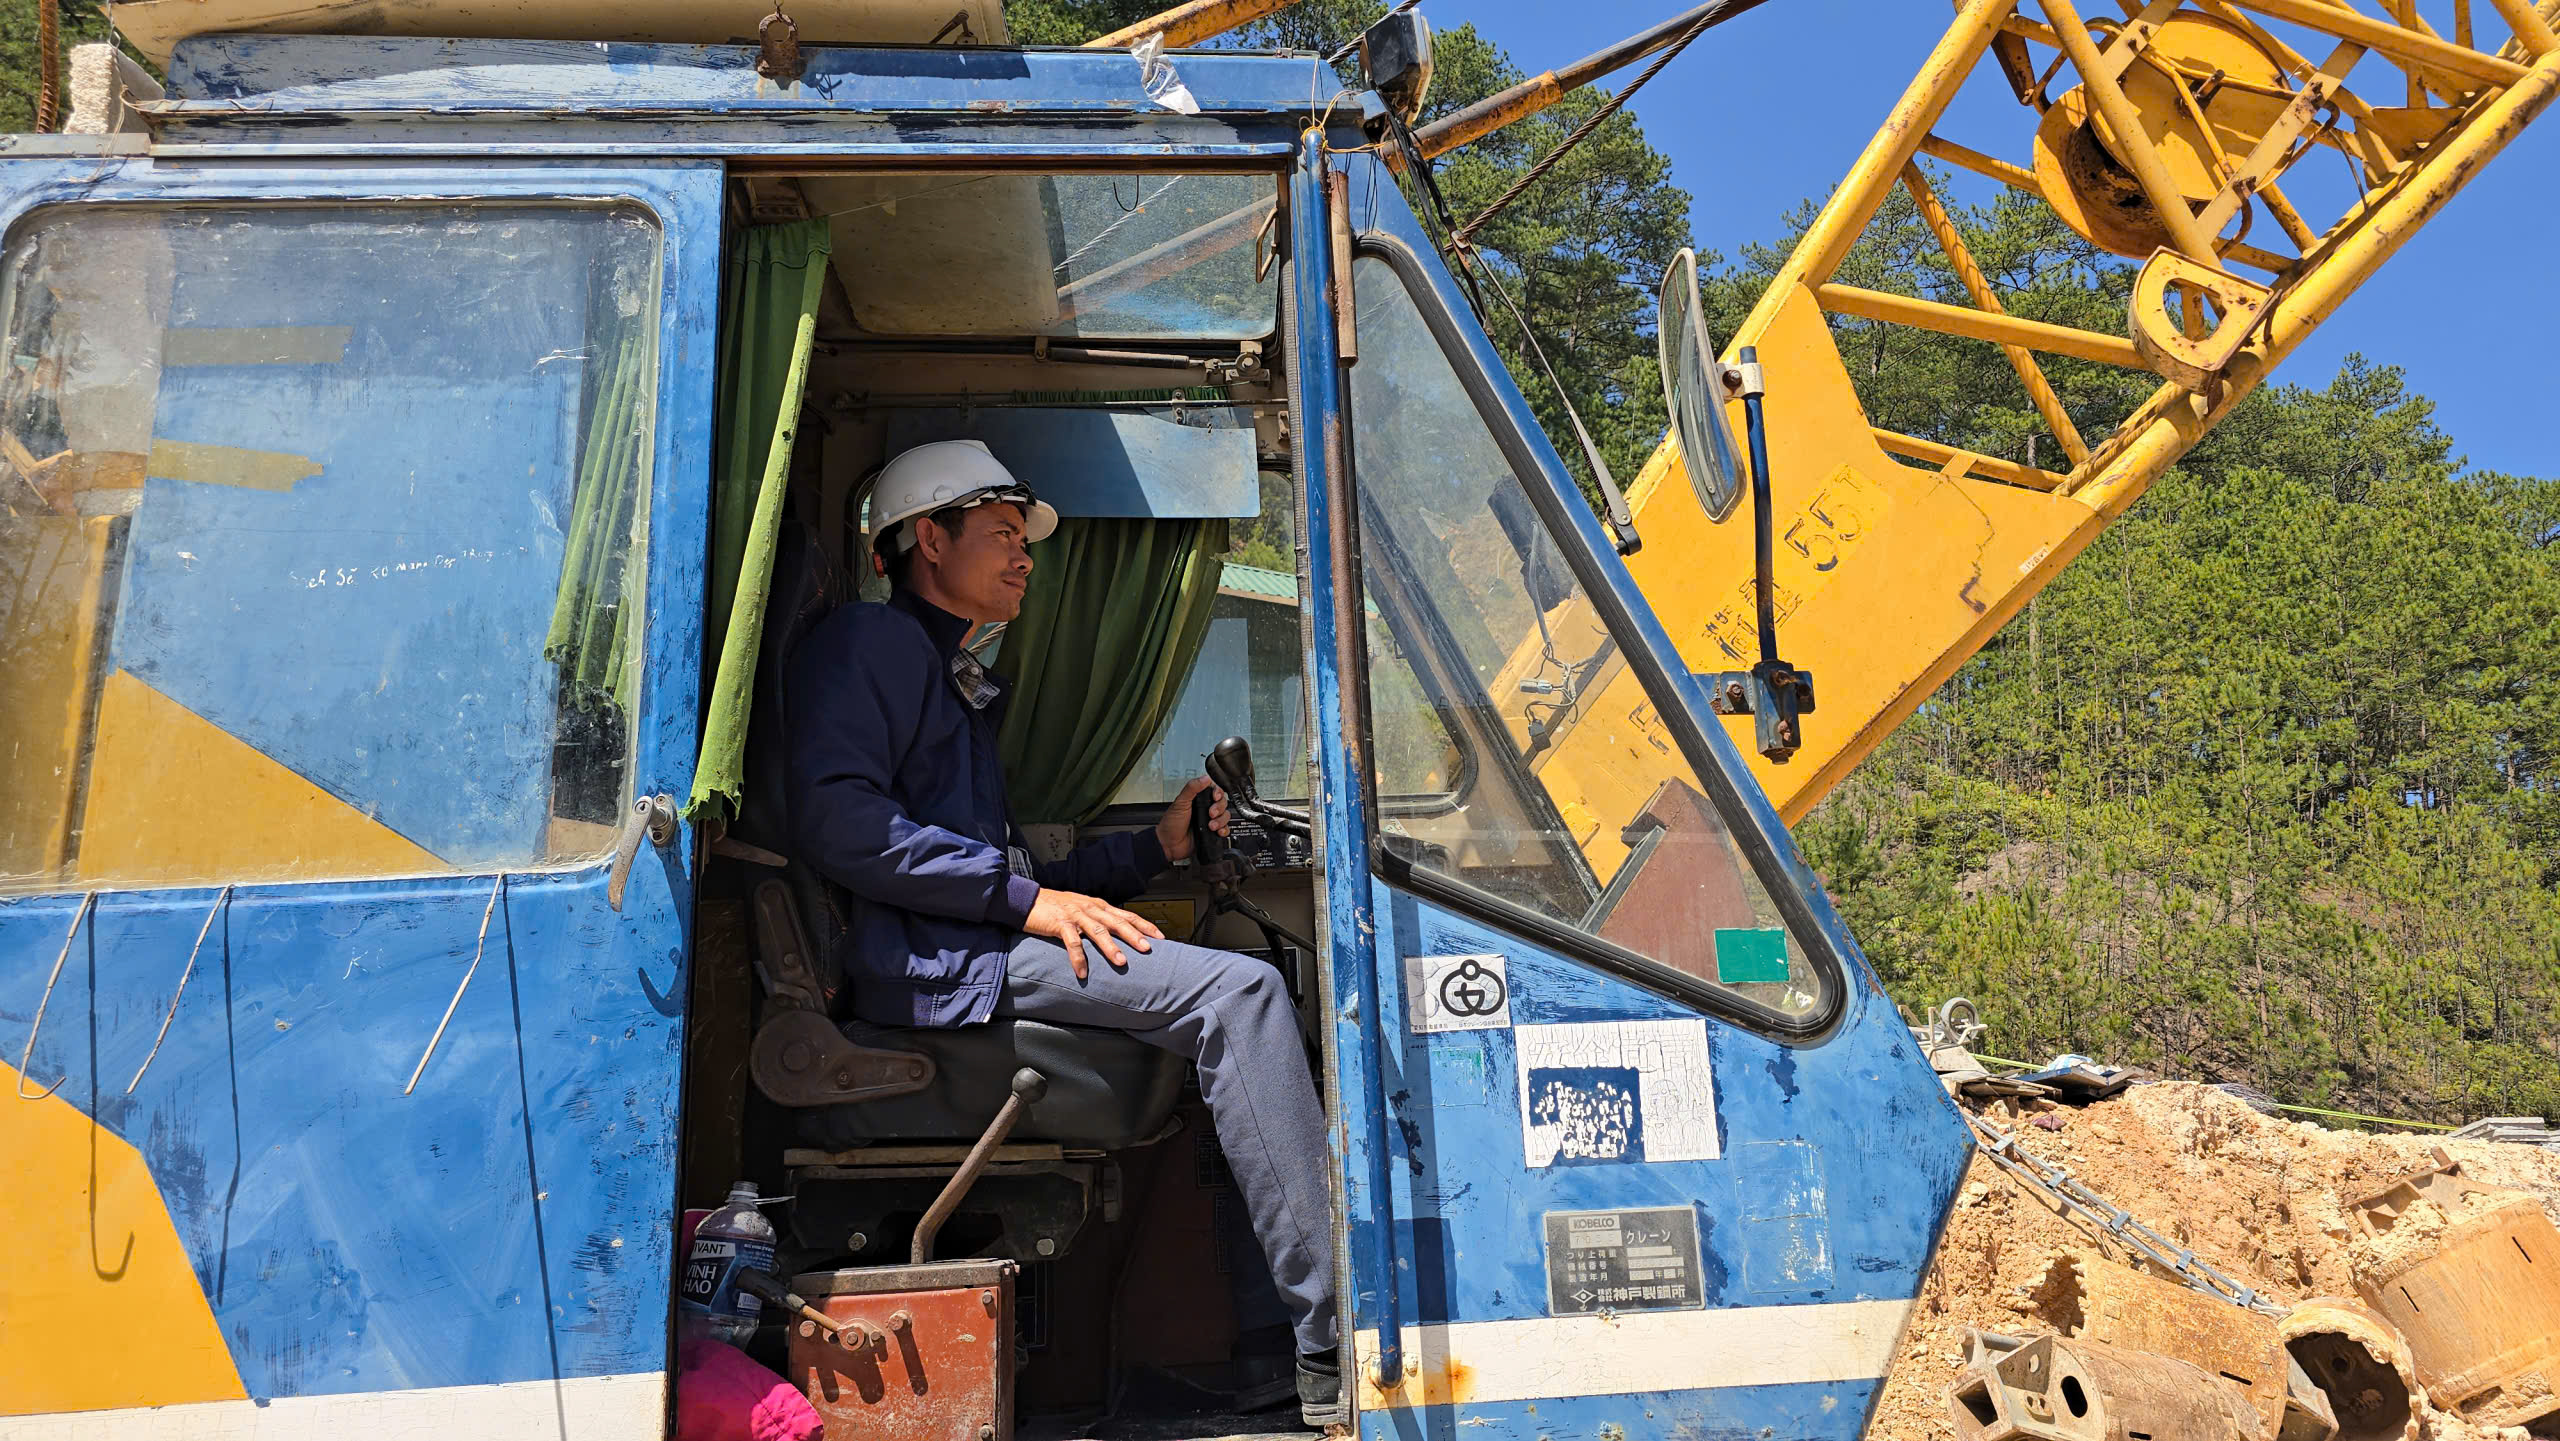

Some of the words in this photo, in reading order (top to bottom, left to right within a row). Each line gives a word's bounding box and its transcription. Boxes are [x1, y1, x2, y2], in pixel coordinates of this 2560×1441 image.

[1573, 1217, 1615, 1229] KOBELCO
[1626, 1230, 1671, 1245] クレーン
